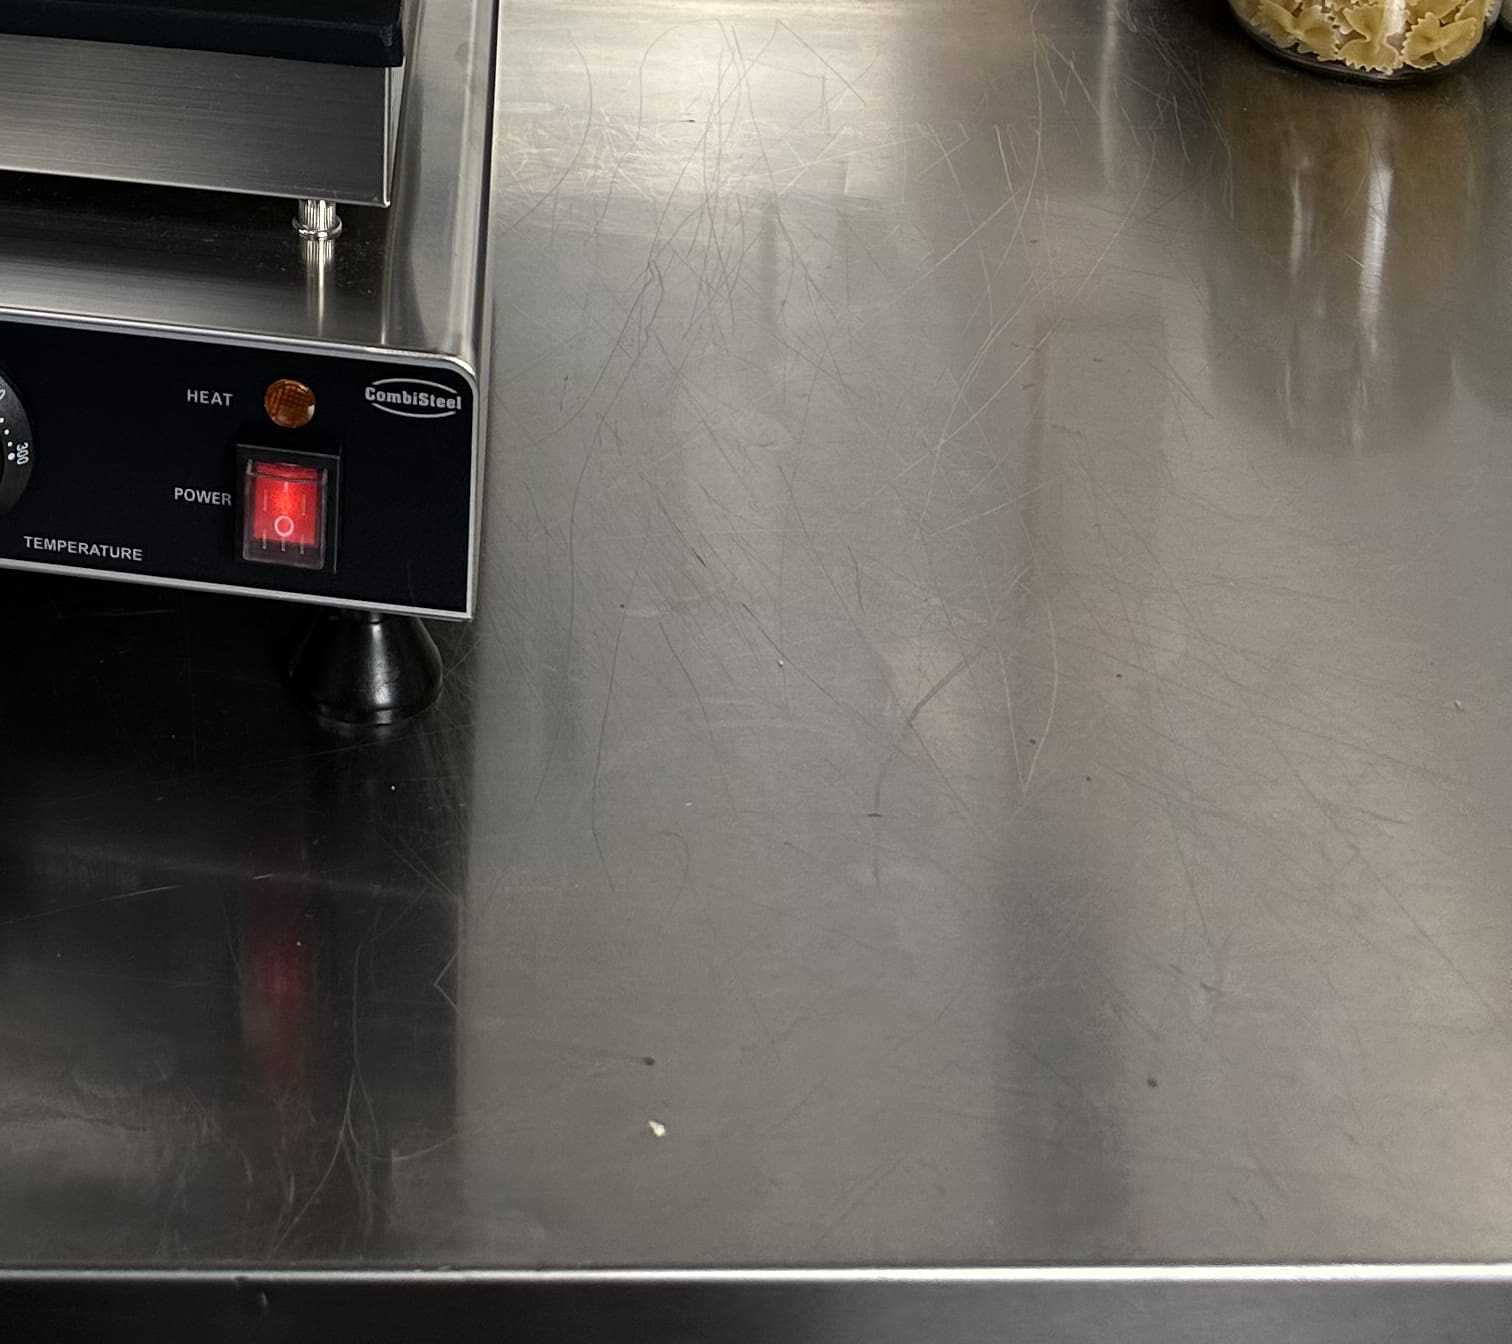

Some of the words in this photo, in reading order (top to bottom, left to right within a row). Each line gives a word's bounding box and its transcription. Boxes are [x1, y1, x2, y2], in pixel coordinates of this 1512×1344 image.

[187, 389, 233, 407] HEAT
[365, 386, 462, 410] CombiSteel
[16, 442, 29, 465] 300
[174, 487, 232, 507] POWER
[23, 535, 143, 562] TEMPERATURE
